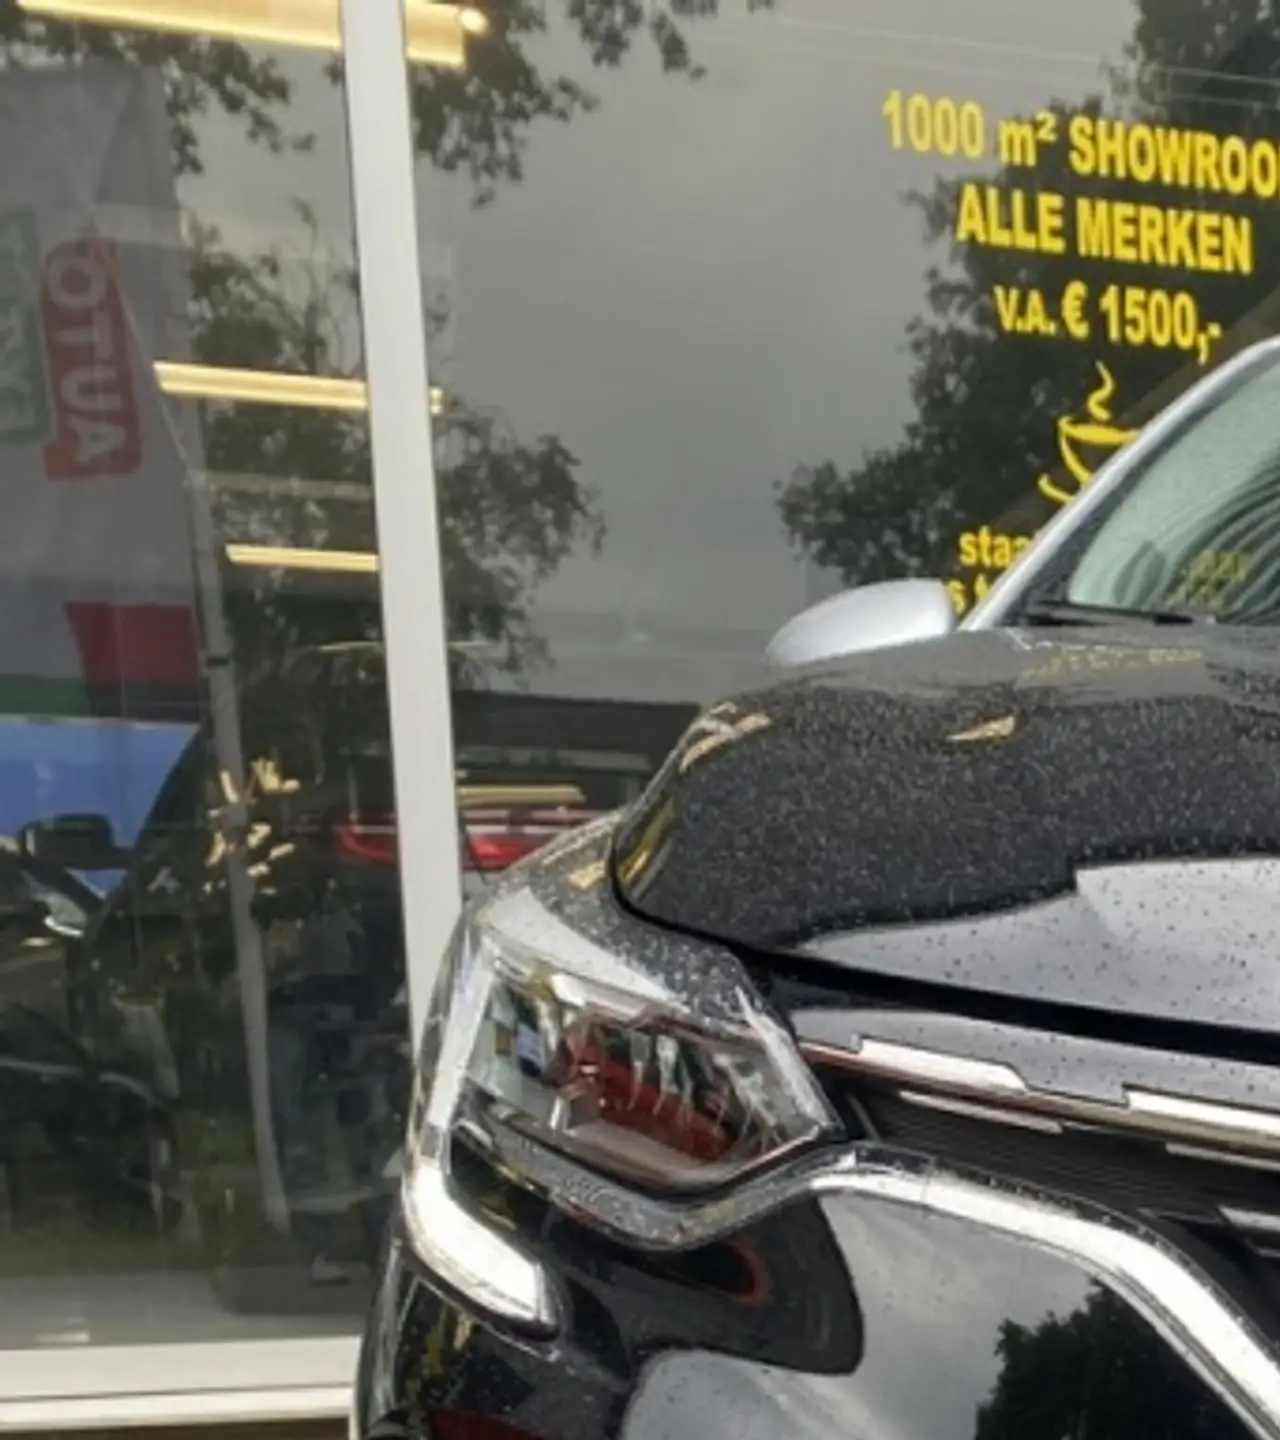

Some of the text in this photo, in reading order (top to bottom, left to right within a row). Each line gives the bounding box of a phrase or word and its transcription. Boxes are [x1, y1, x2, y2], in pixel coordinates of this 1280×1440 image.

[882, 90, 984, 159] 1000
[999, 111, 1057, 167] m²
[956, 183, 1253, 275] ALLE MERKEN
[994, 280, 1222, 365] V.A. € 1500,-
